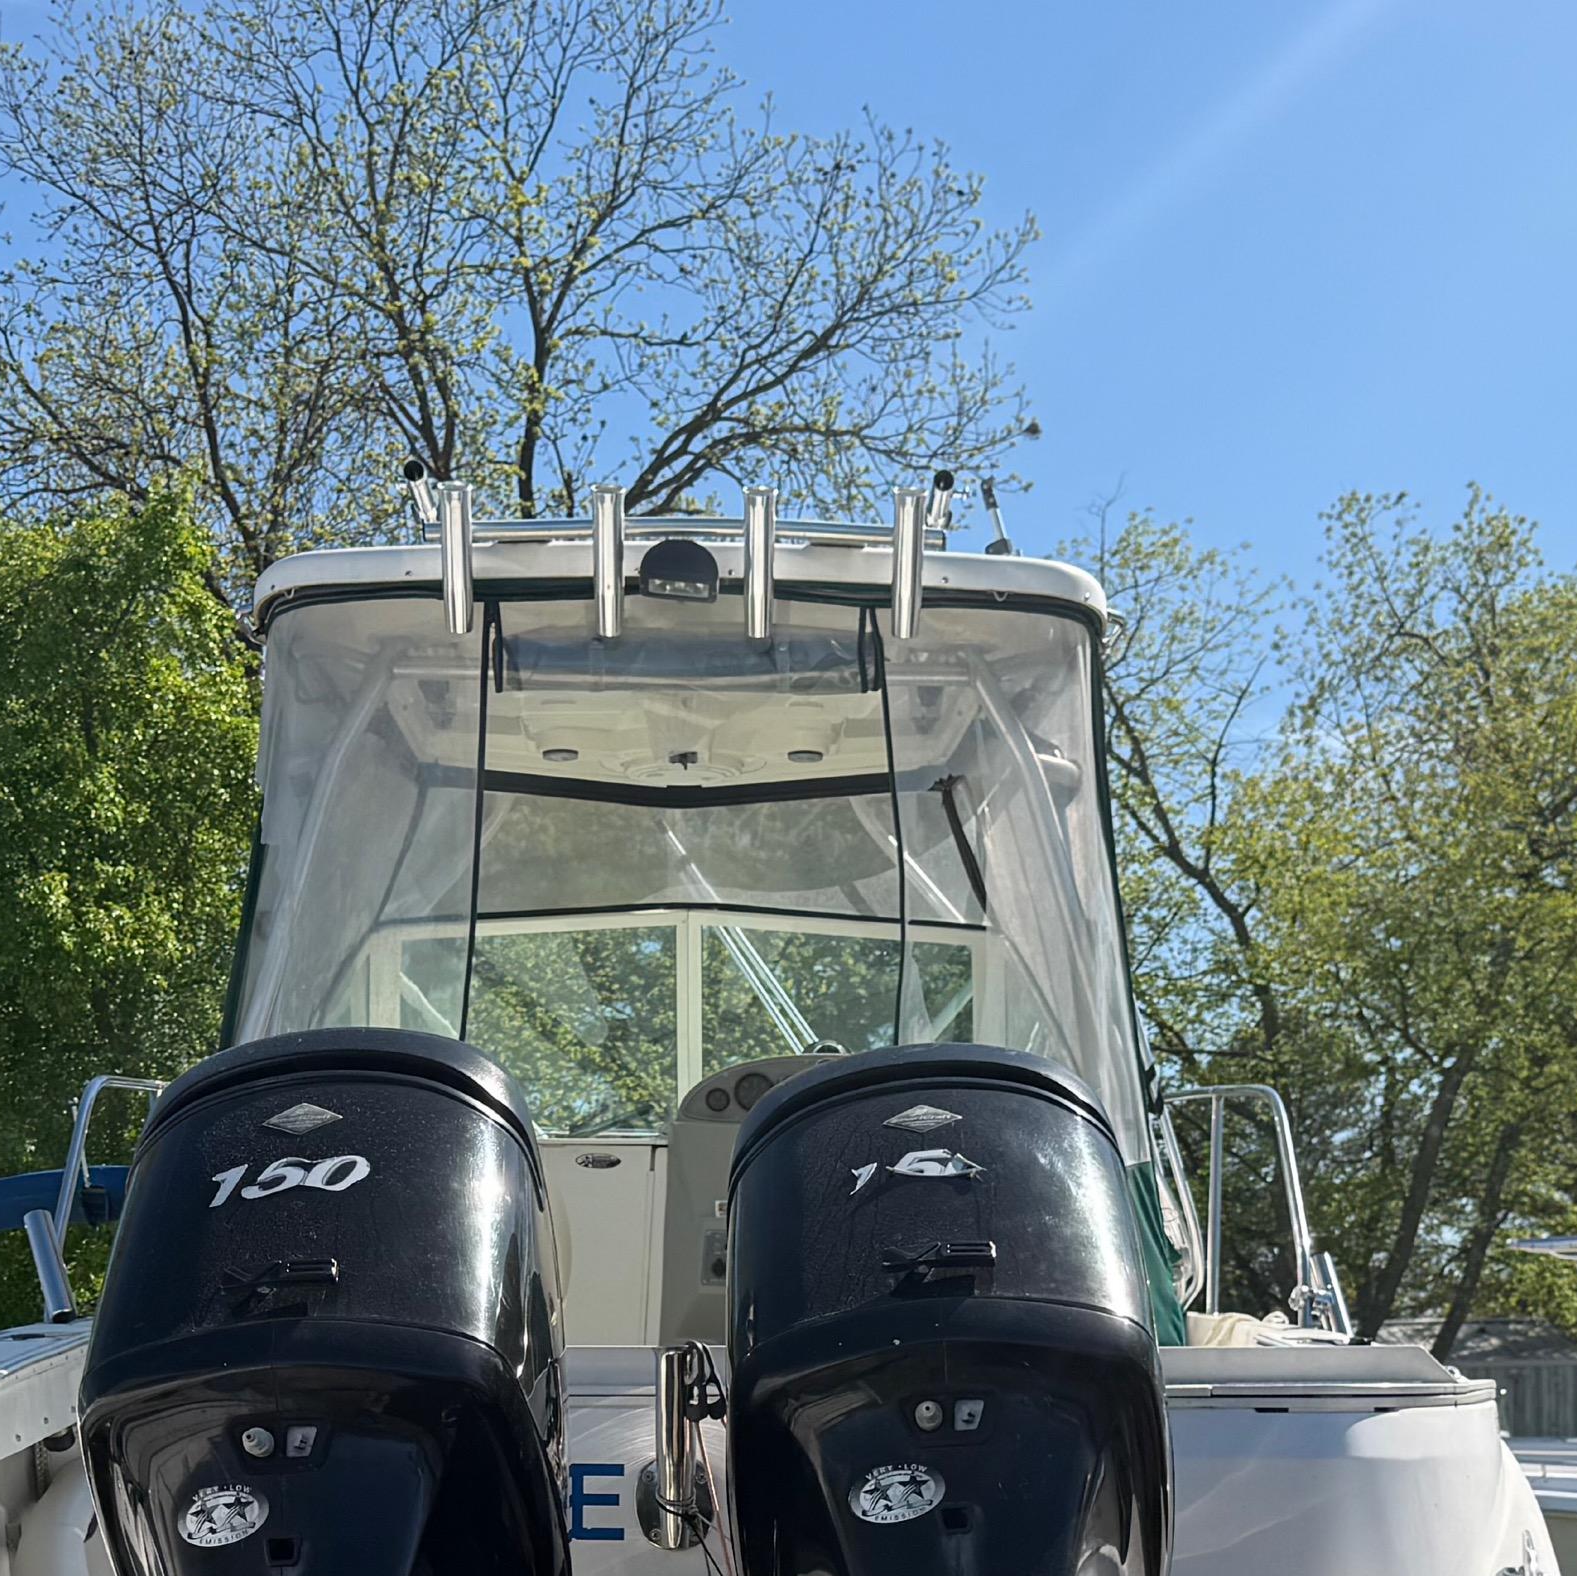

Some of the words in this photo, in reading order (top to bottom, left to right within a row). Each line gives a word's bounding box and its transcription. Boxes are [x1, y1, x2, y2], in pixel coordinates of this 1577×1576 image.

[209, 1155, 370, 1208] 150
[865, 1465, 893, 1480] VERY
[904, 1463, 928, 1473] LOW
